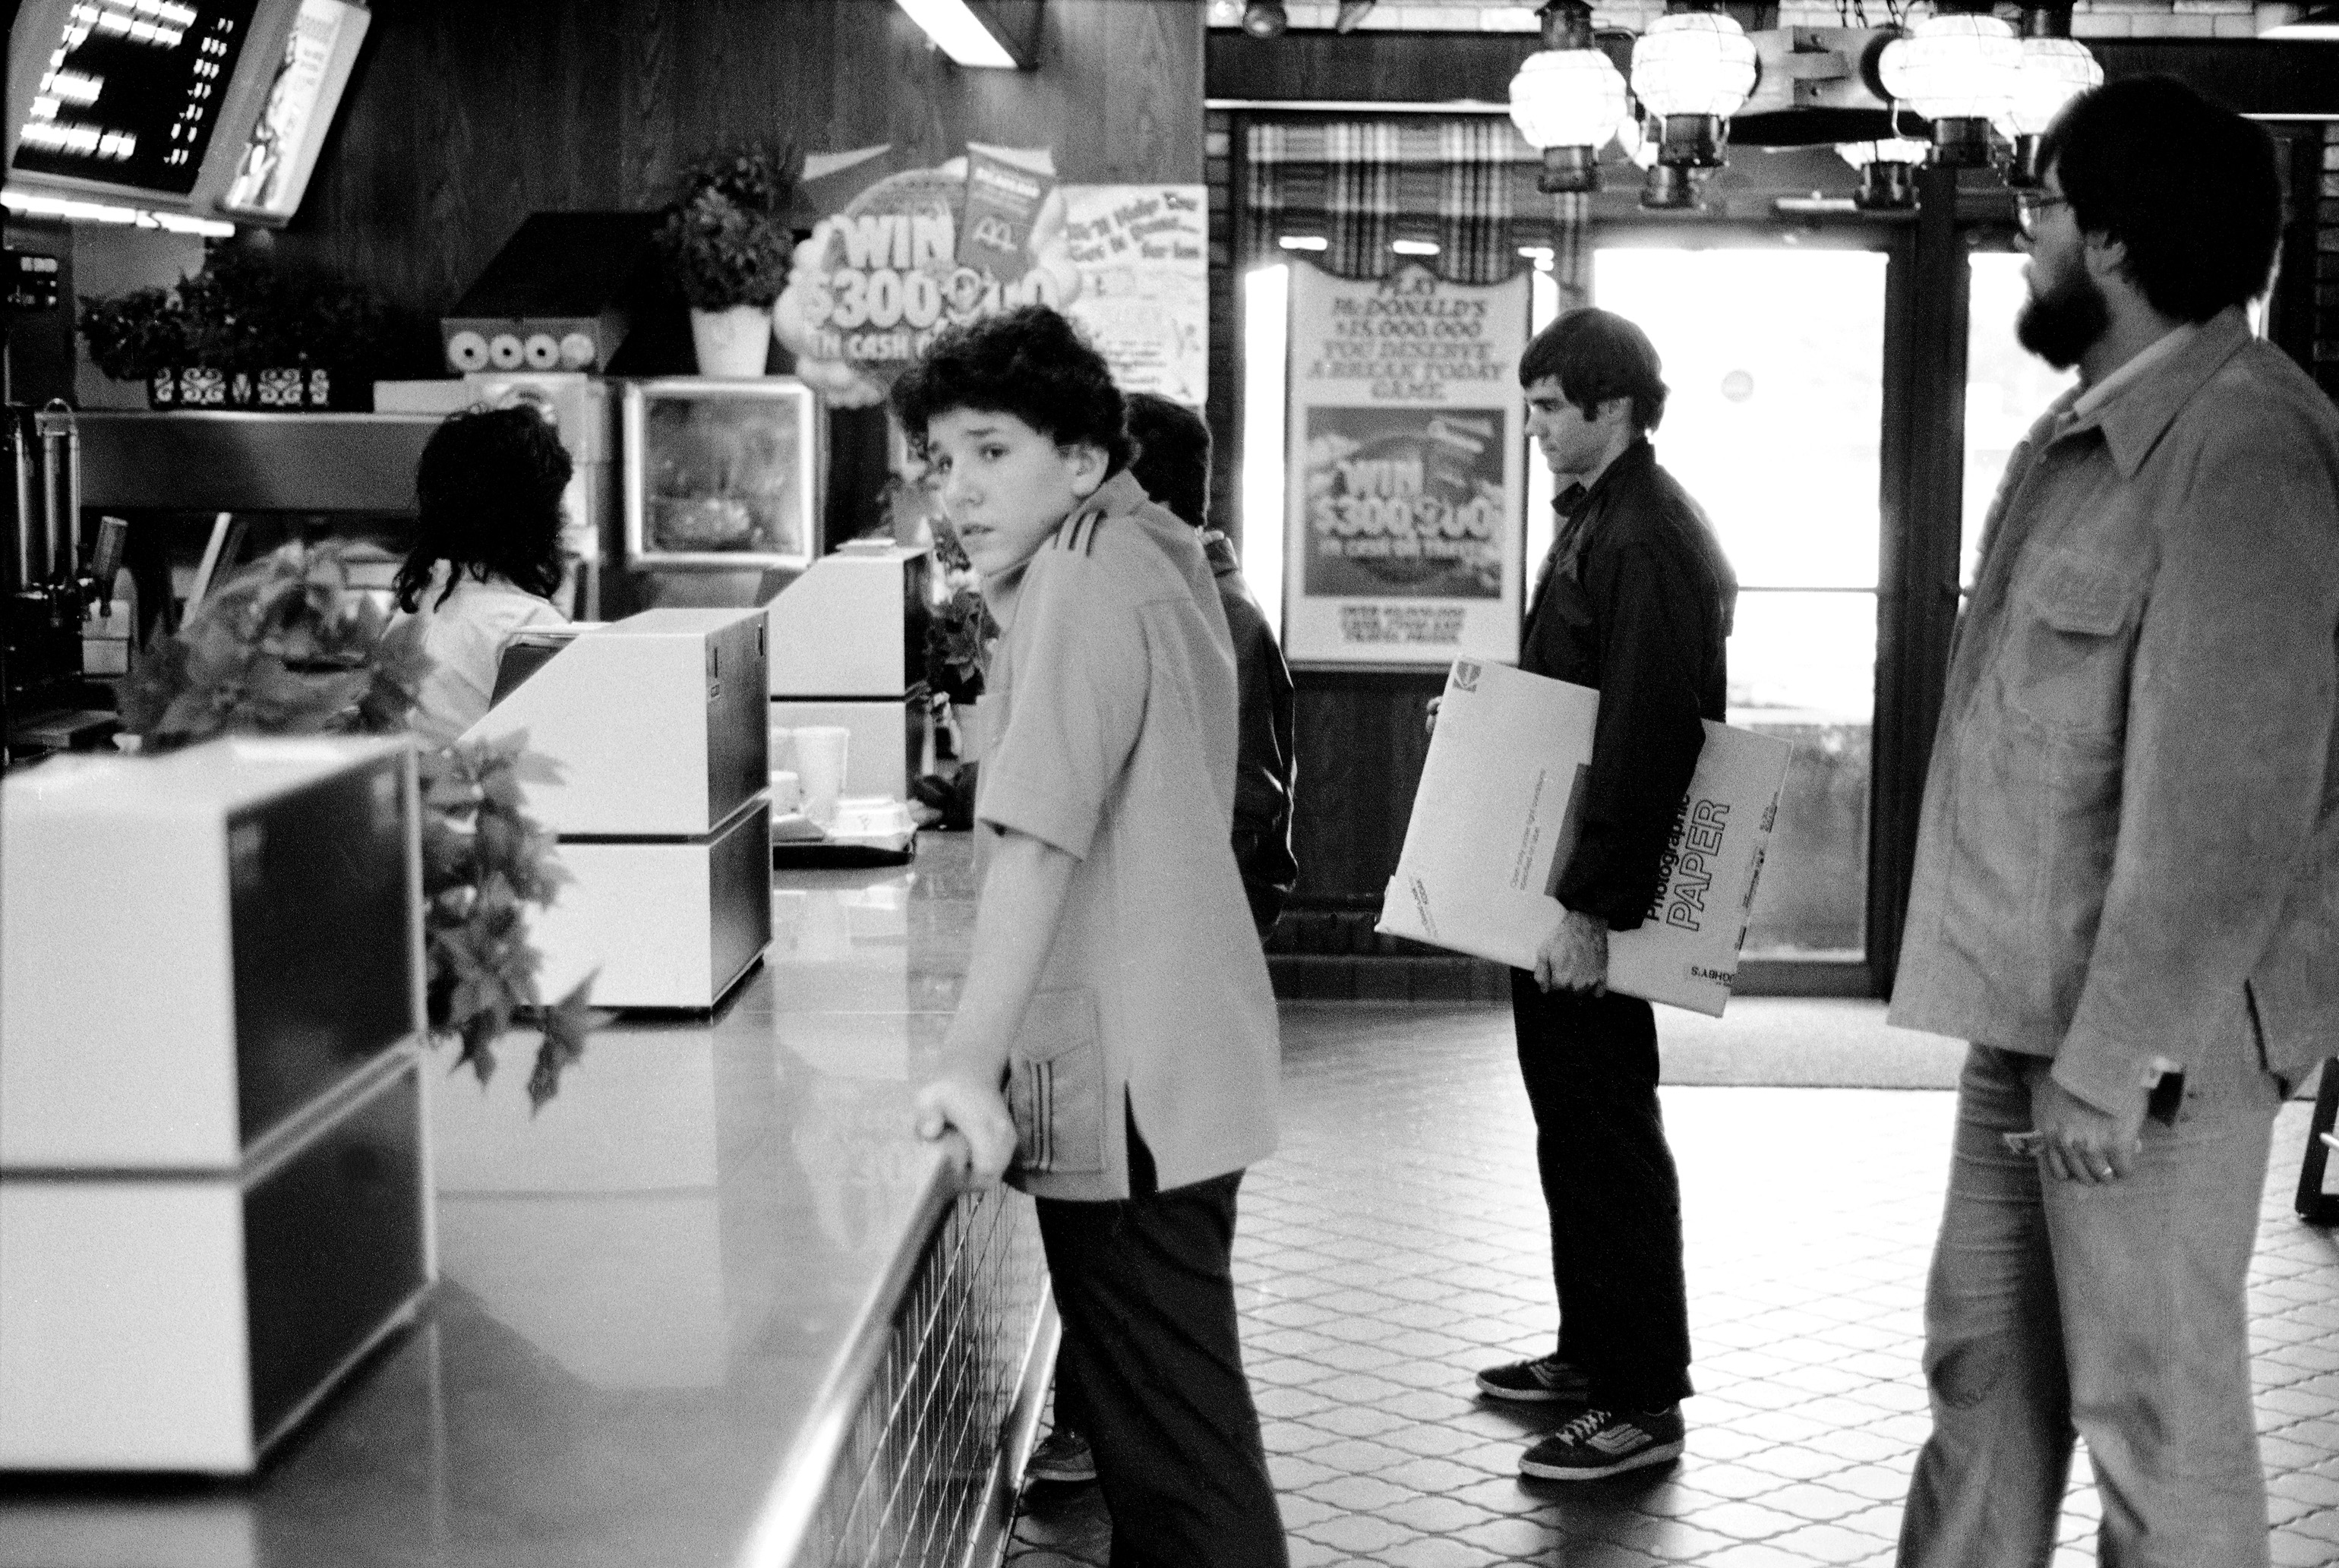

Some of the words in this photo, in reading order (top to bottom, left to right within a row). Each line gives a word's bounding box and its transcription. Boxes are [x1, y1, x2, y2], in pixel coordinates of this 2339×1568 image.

[844, 213, 955, 267] WIN
[1324, 342, 1373, 360] YOU
[1343, 459, 1423, 496] WIN
[1646, 793, 1690, 922] Photographic
[1665, 799, 1731, 932] PAPER
